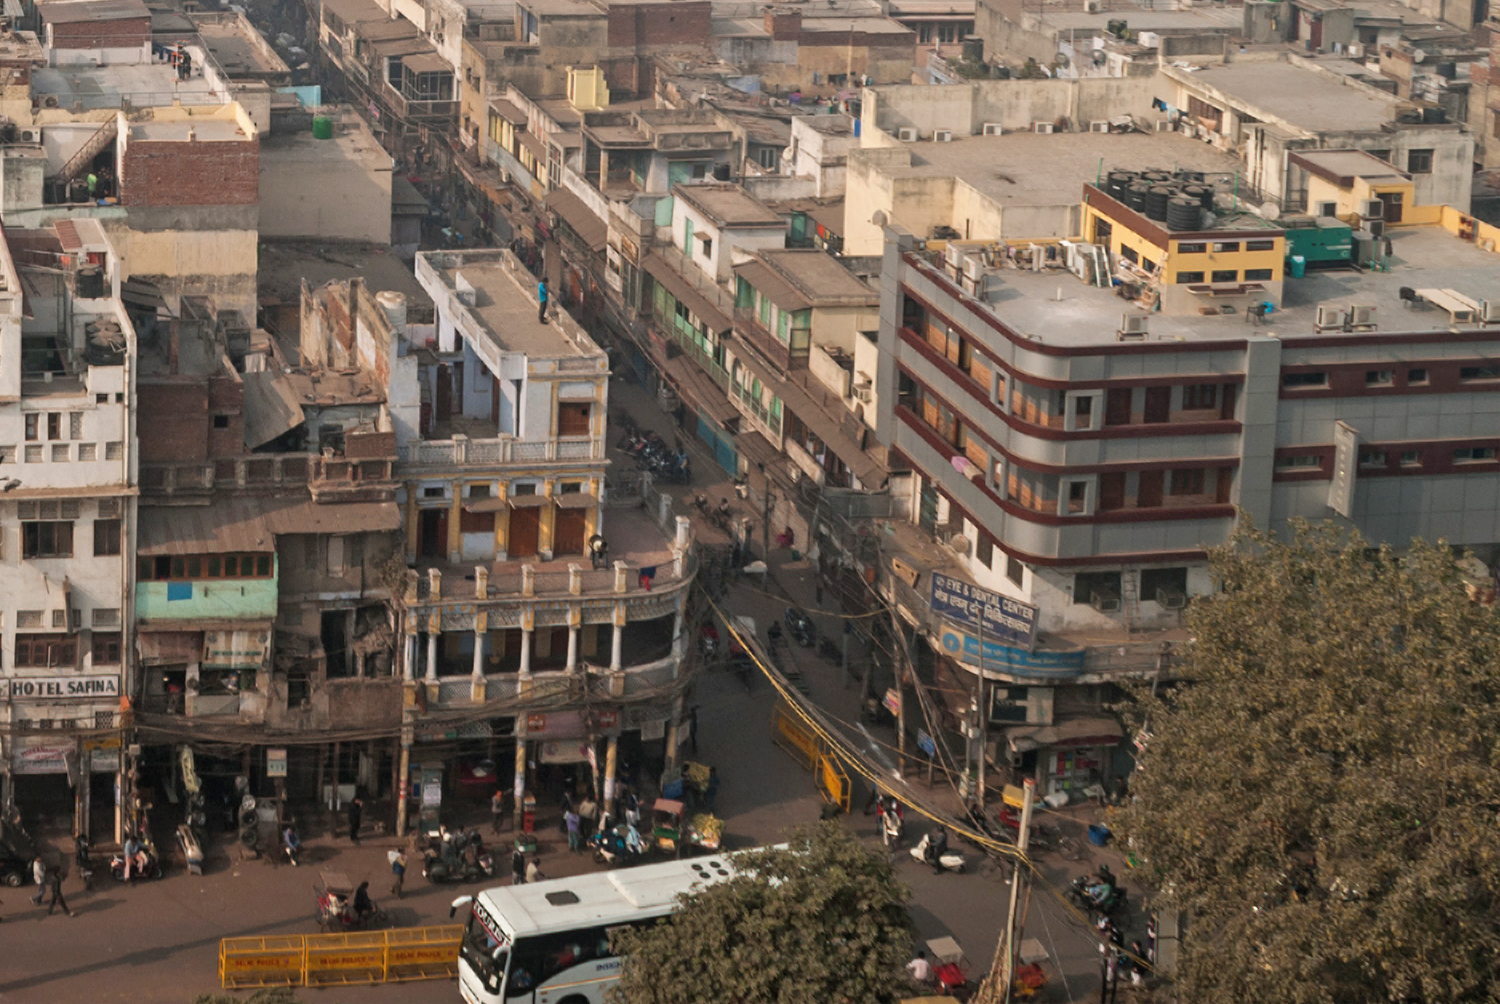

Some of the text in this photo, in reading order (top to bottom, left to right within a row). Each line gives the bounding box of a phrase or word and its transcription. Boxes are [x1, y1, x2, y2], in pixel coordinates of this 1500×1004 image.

[947, 579, 1033, 620] EYE & DENTAL CENTER
[12, 678, 116, 696] HOTEL SAFINA
[472, 901, 511, 947] TOURIST
